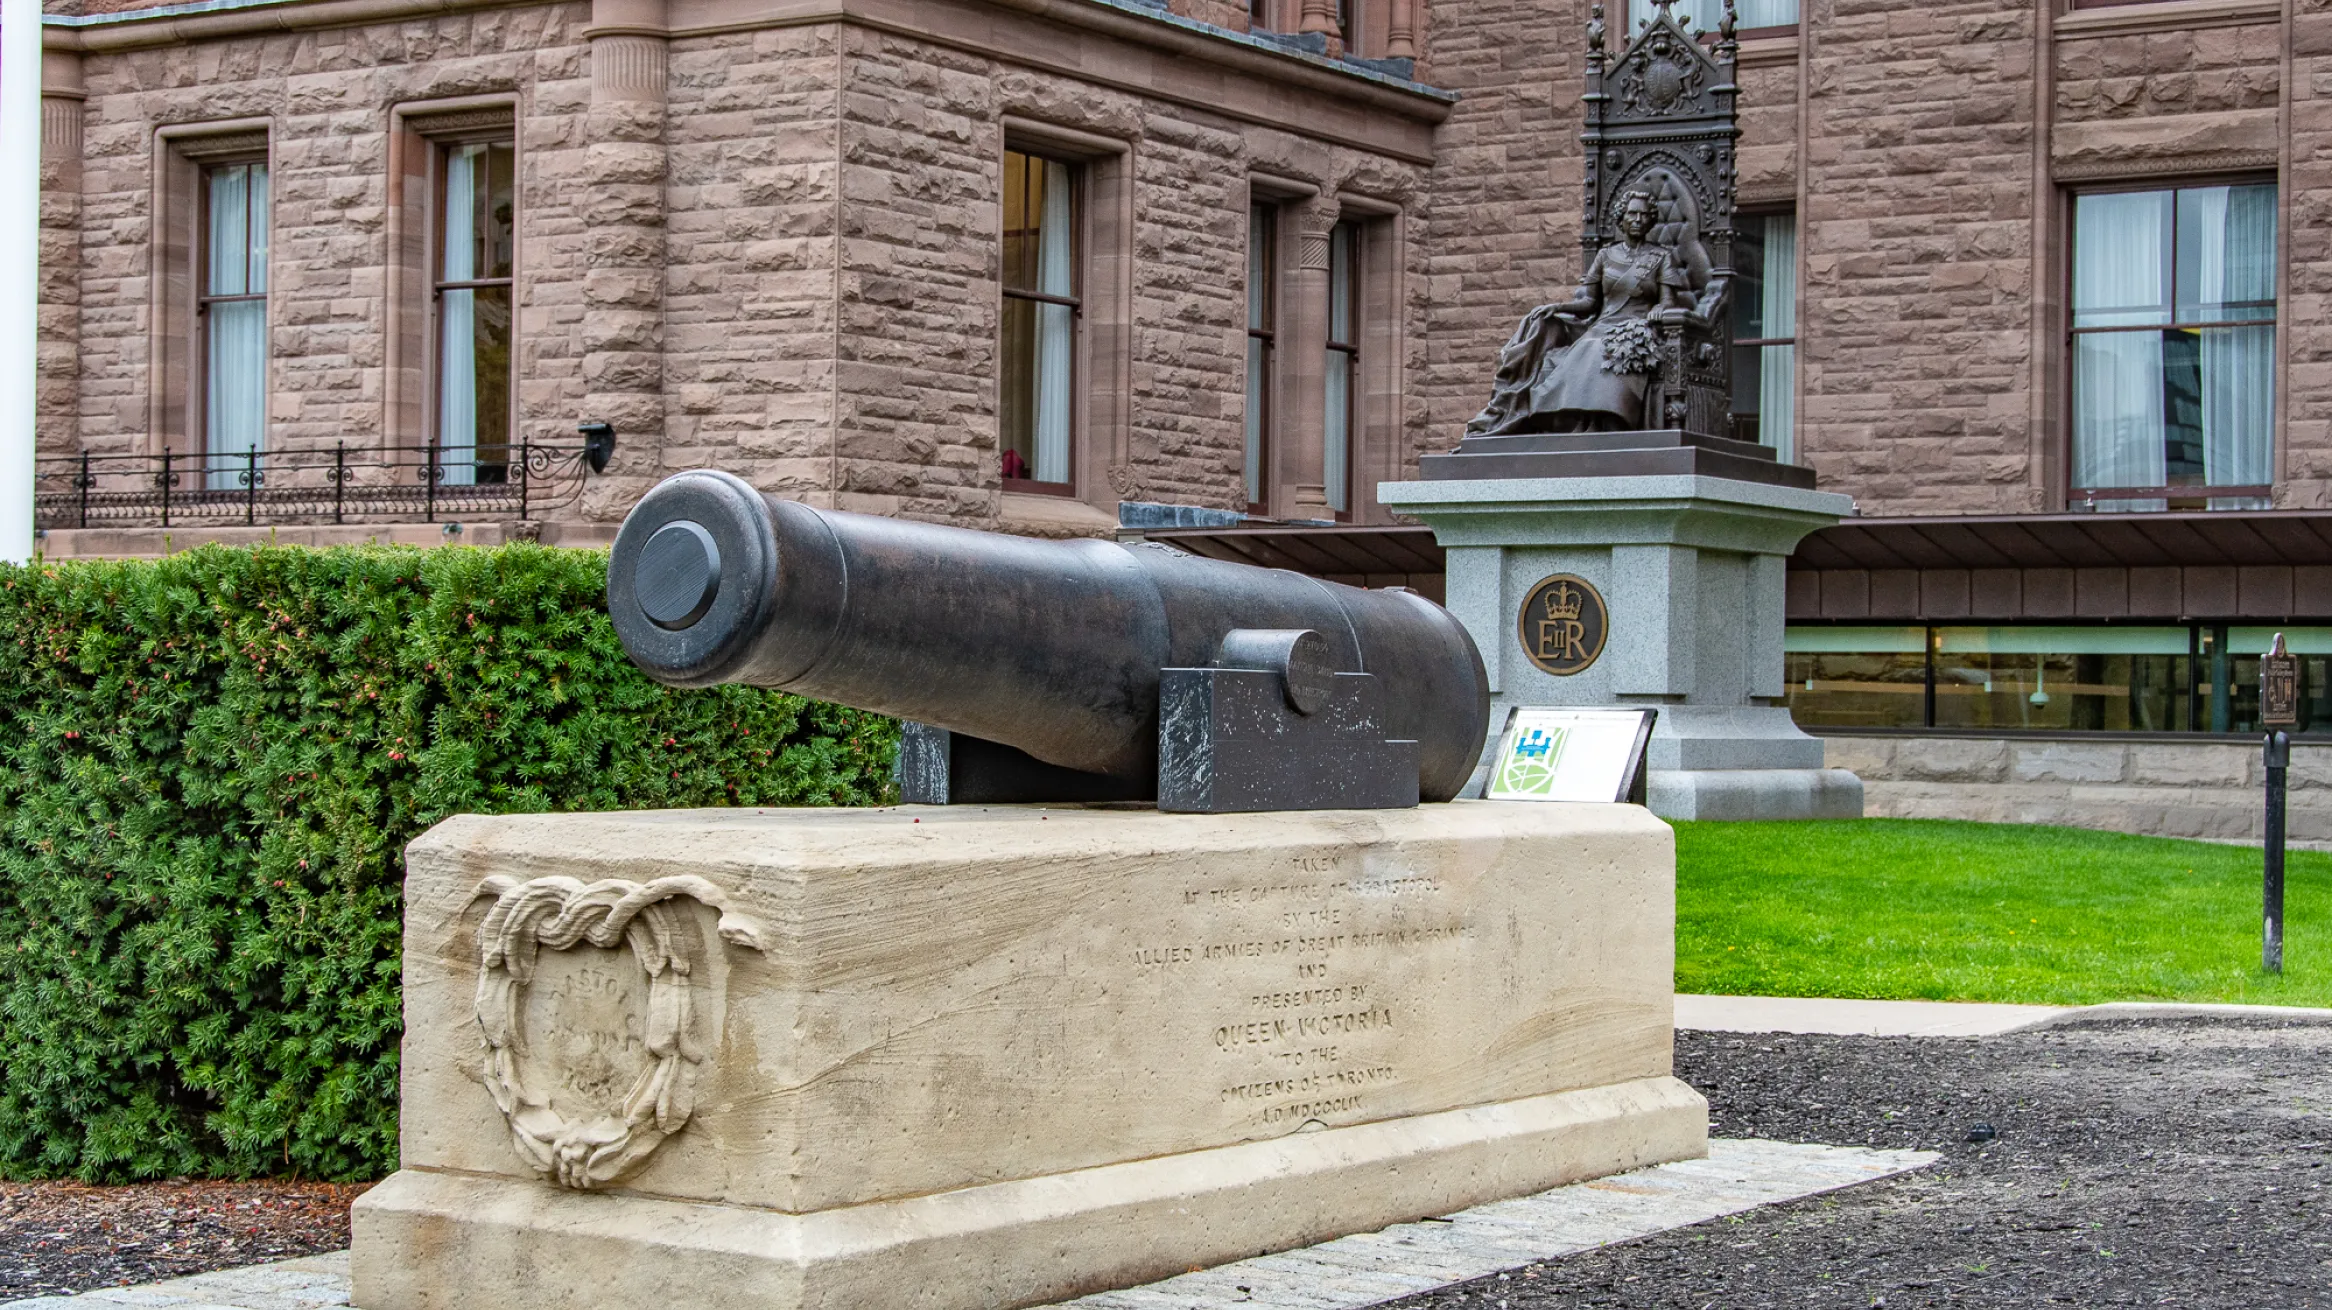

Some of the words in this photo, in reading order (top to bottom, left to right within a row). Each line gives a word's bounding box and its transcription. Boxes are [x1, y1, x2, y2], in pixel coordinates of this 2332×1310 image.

[1291, 857, 1341, 872] TAKEN
[1210, 888, 1242, 904] THE
[1283, 912, 1301, 928] BY
[1309, 909, 1340, 925] THE
[1133, 948, 1193, 965] ALLIED
[1202, 942, 1263, 961] ARMIES
[1271, 939, 1291, 956] OF
[1298, 935, 1345, 956] GREAT
[1299, 963, 1327, 979] AND
[1252, 988, 1342, 1009] PRESENTED
[1350, 984, 1368, 1001] BY
[1298, 1008, 1393, 1037] VICTORIA
[1282, 1052, 1303, 1066] TO
[1310, 1046, 1338, 1063] THE
[1221, 1079, 1294, 1103] CITIZENS
[1301, 1075, 1320, 1095] OF
